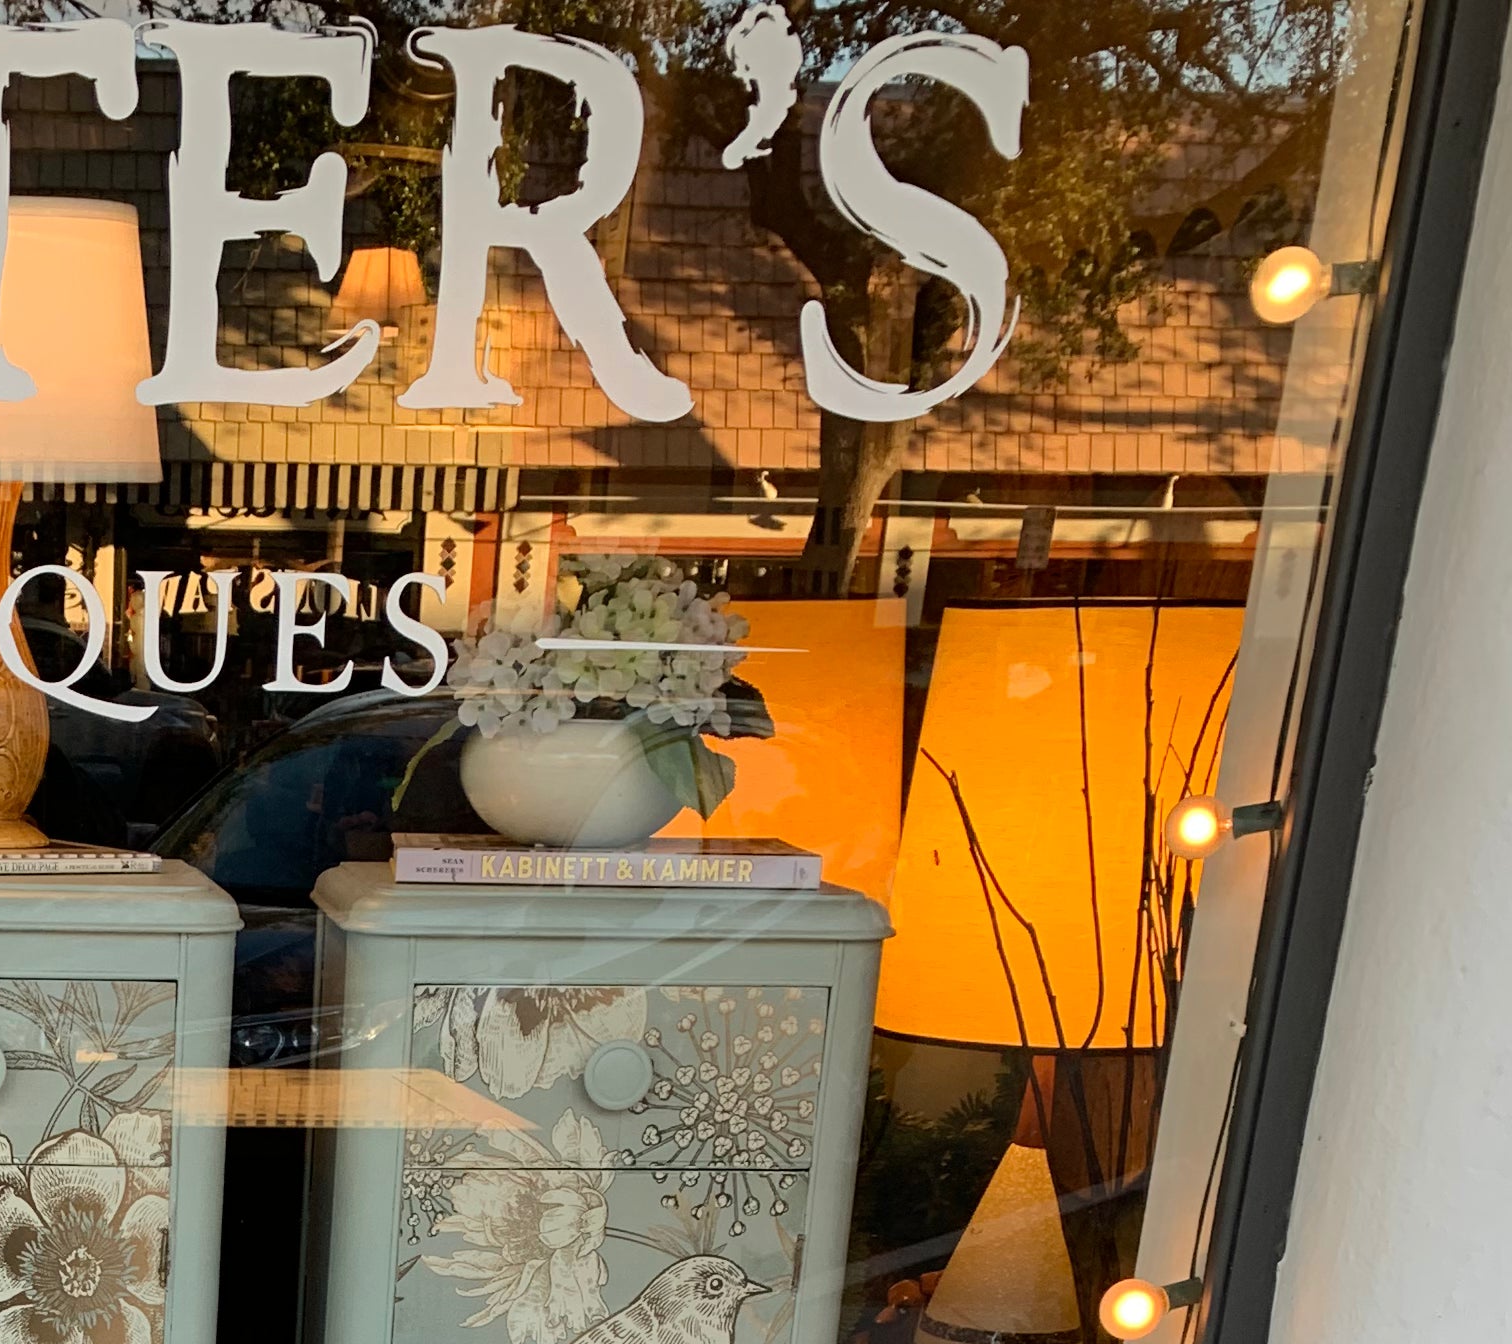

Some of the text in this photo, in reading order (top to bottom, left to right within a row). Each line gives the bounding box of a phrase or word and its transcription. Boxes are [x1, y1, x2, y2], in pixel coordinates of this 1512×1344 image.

[12, 862, 60, 872] DECOUPAGE
[481, 854, 753, 883] KABINETT & KAMMER
